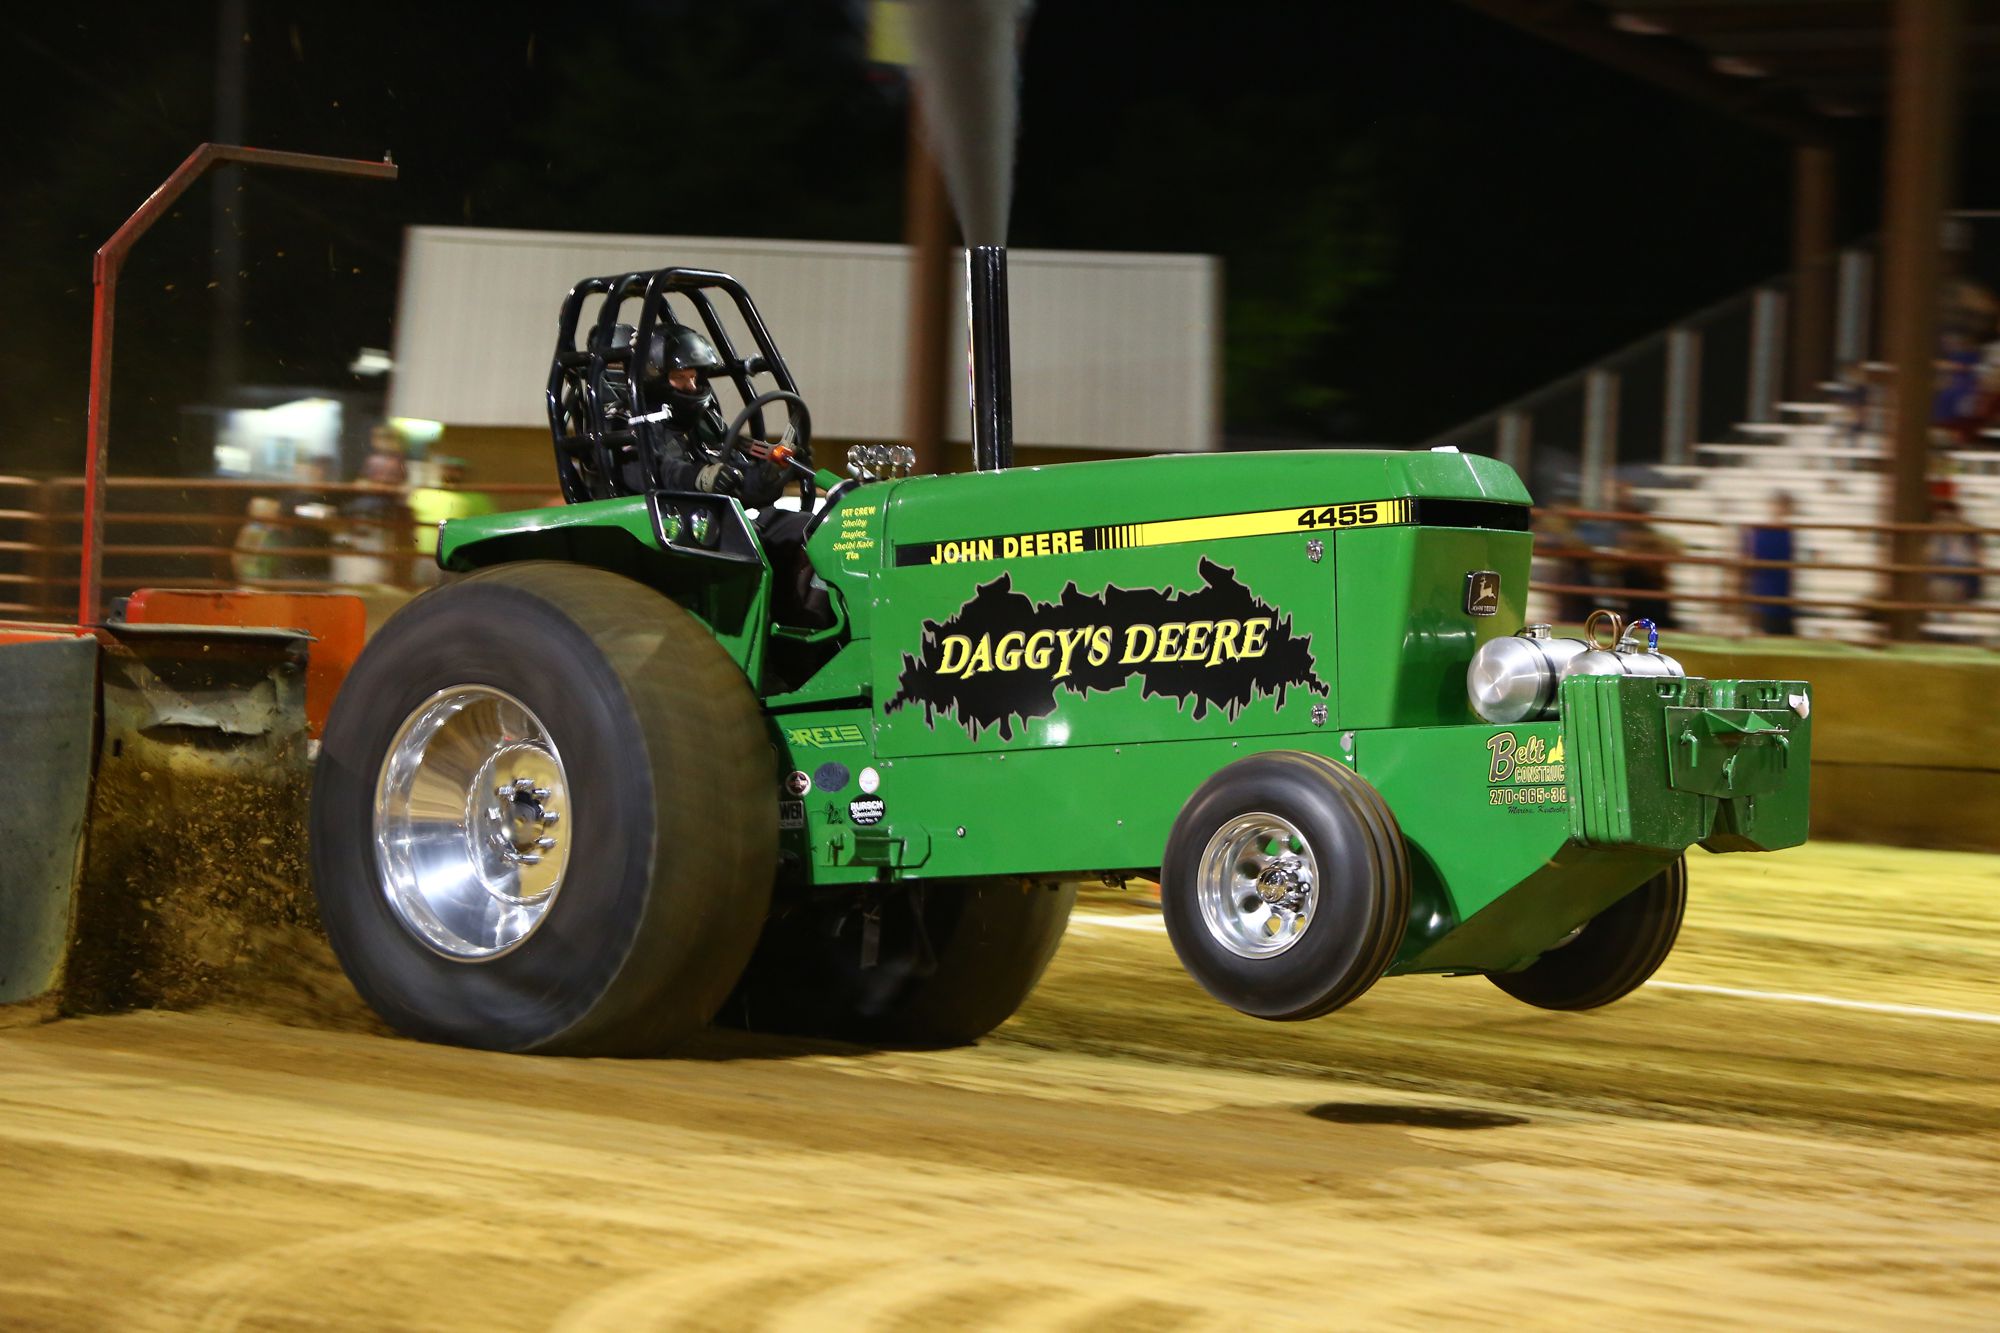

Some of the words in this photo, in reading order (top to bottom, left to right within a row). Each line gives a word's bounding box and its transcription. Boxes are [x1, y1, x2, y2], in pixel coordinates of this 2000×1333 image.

[841, 508, 853, 518] PIT
[854, 506, 876, 517] CREW
[1297, 503, 1378, 528] 4455
[930, 539, 994, 565] JOHN
[1003, 530, 1084, 559] DEERE
[936, 624, 1112, 680] DAGGY'S
[1118, 618, 1272, 668] DEERE
[1487, 731, 1546, 783] Belt
